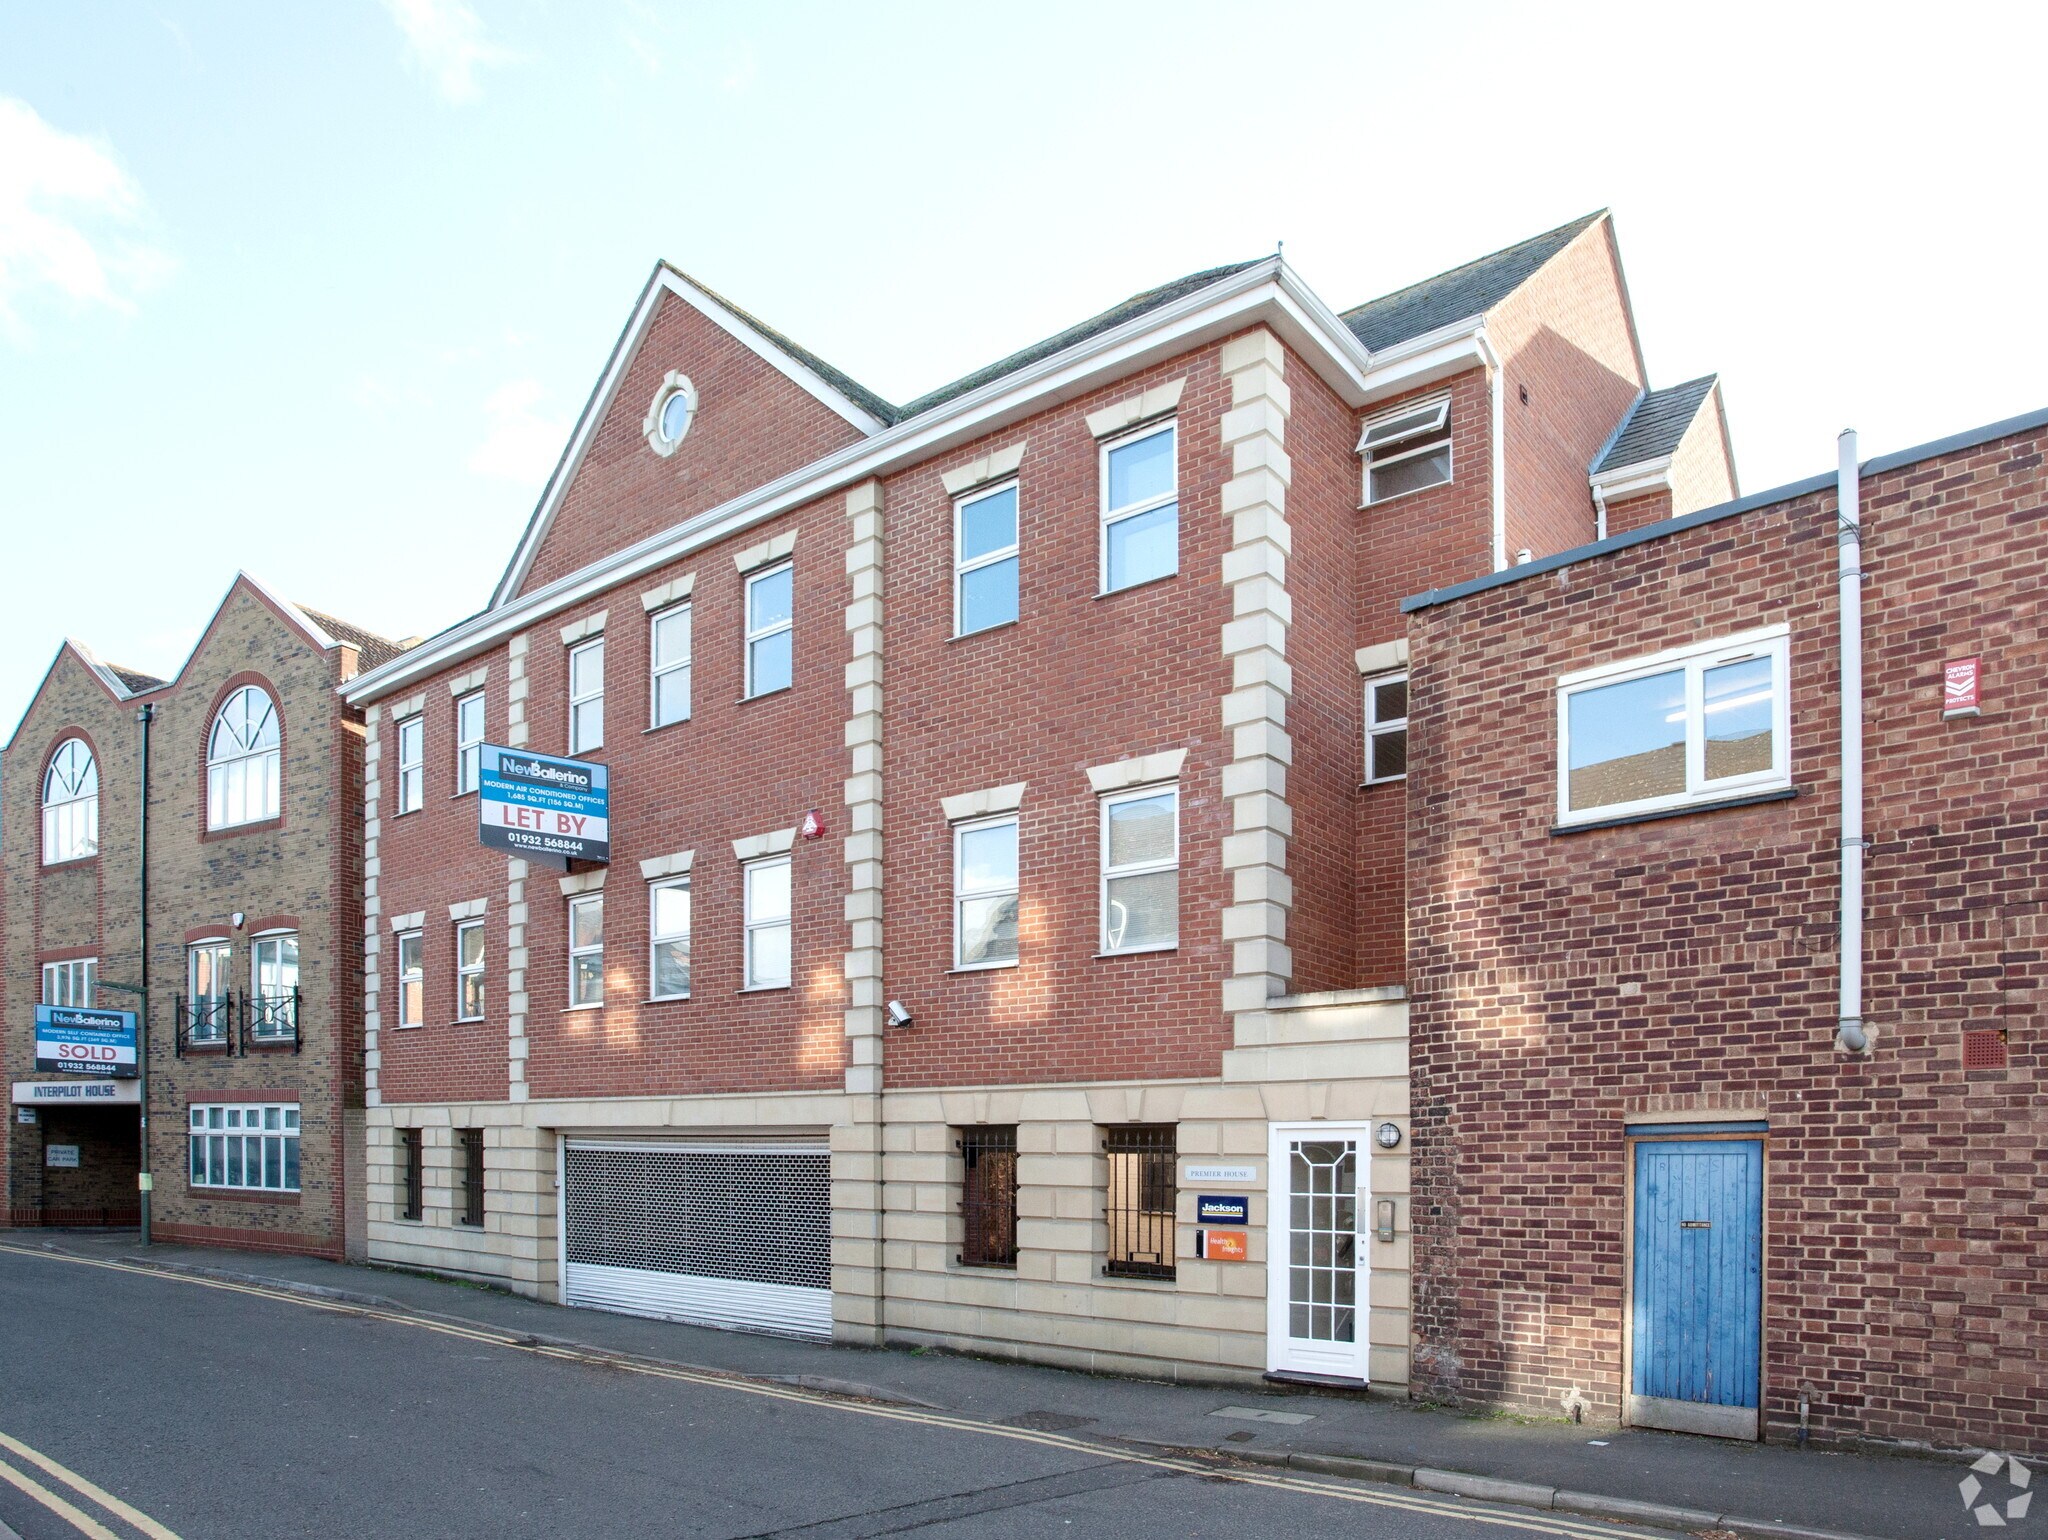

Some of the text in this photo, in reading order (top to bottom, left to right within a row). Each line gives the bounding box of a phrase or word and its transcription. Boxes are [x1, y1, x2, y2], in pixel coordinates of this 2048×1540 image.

[1946, 664, 1975, 674] CHEVRON
[1948, 670, 1974, 679] ALARMS
[1946, 695, 1975, 704] PROTECTS
[502, 757, 588, 785] NewBallerino
[484, 780, 605, 805] MODERN AIR CONDITIONED OFFICES
[564, 784, 588, 792] Company
[507, 792, 526, 800] 1,685
[548, 797, 562, 806] (156
[503, 805, 587, 836] LET BY
[508, 832, 583, 851] 01932 568844
[514, 843, 578, 856] www.newballerino.co.uk
[53, 1012, 120, 1027] NewBallerino
[59, 1044, 116, 1060] SOLD
[86, 1063, 116, 1071] 568844
[34, 1085, 115, 1097] INTERPILOT HOUSE
[1202, 1203, 1243, 1212] Jackson
[1222, 1246, 1243, 1254] Insights
